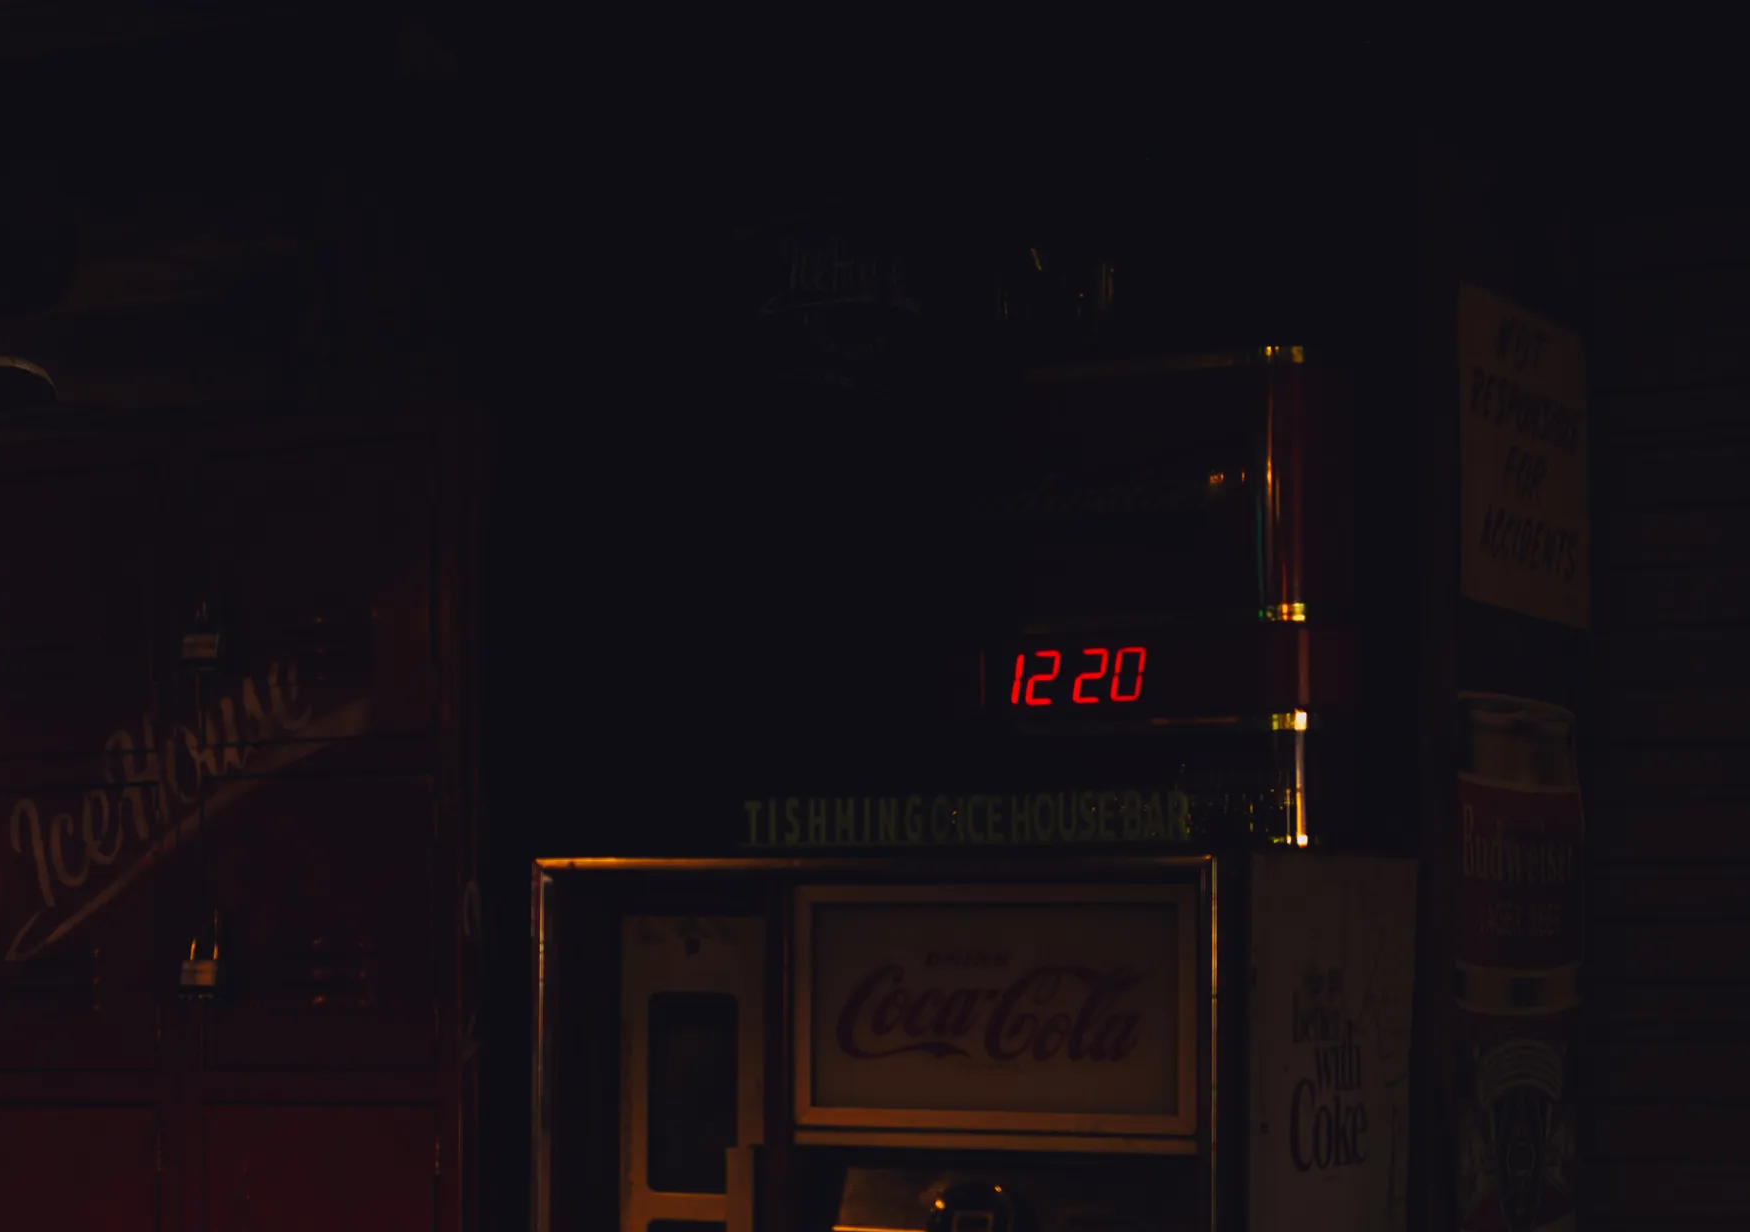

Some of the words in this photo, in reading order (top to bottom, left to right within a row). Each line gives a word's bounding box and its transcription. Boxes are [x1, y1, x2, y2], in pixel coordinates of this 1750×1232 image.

[1494, 317, 1549, 375] NOT
[1011, 791, 1117, 842] HOUSE
[1122, 789, 1190, 841] BAR
[836, 963, 1155, 1062] Coca-Cola
[1313, 1019, 1364, 1093] with
[1289, 1077, 1369, 1173] Coke
